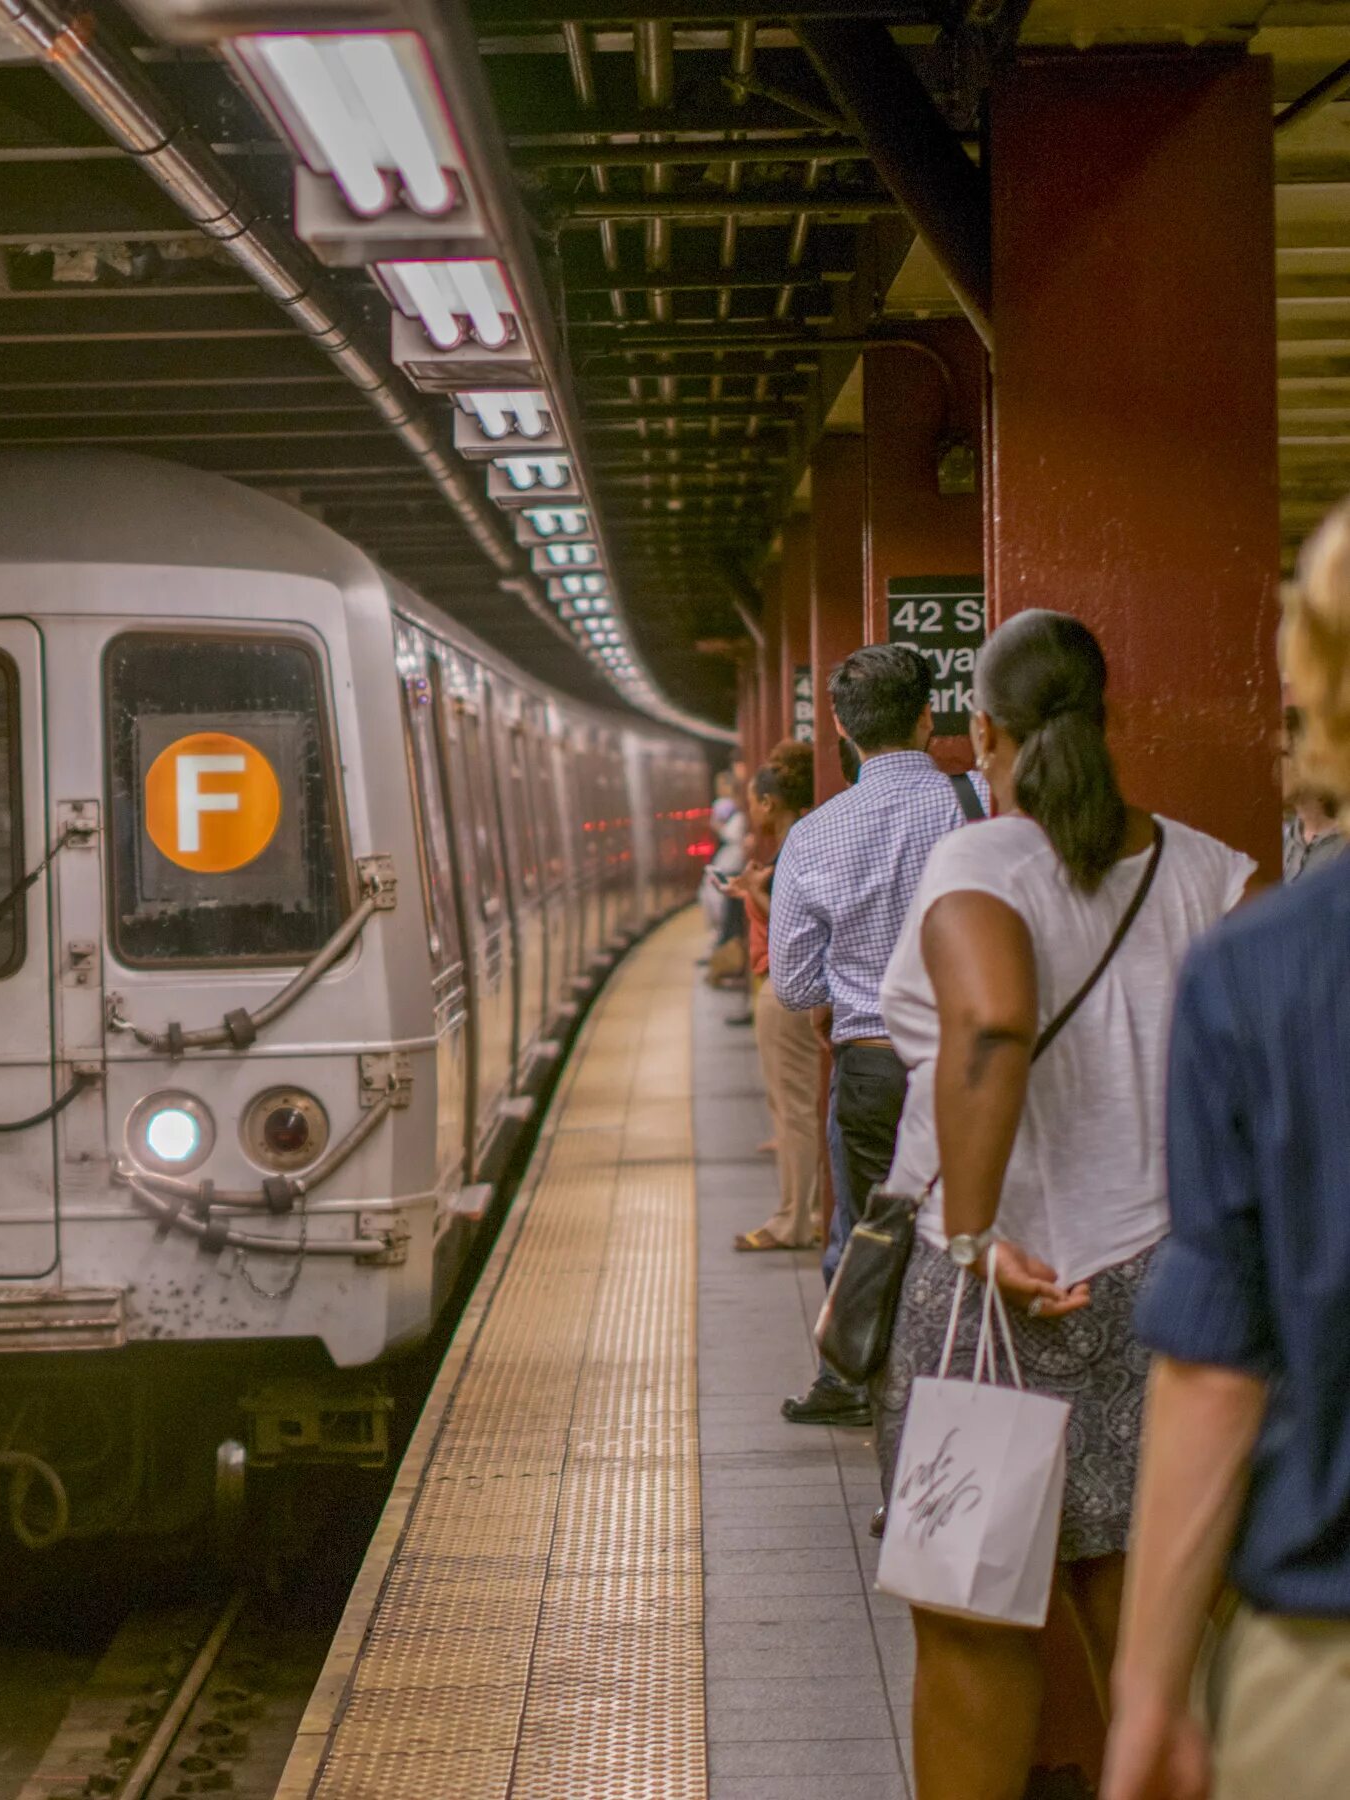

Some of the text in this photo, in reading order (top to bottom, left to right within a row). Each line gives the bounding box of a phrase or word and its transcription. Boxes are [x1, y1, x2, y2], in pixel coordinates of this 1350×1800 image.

[893, 600, 943, 632] 42
[928, 681, 979, 713] ark
[176, 754, 246, 853] F
